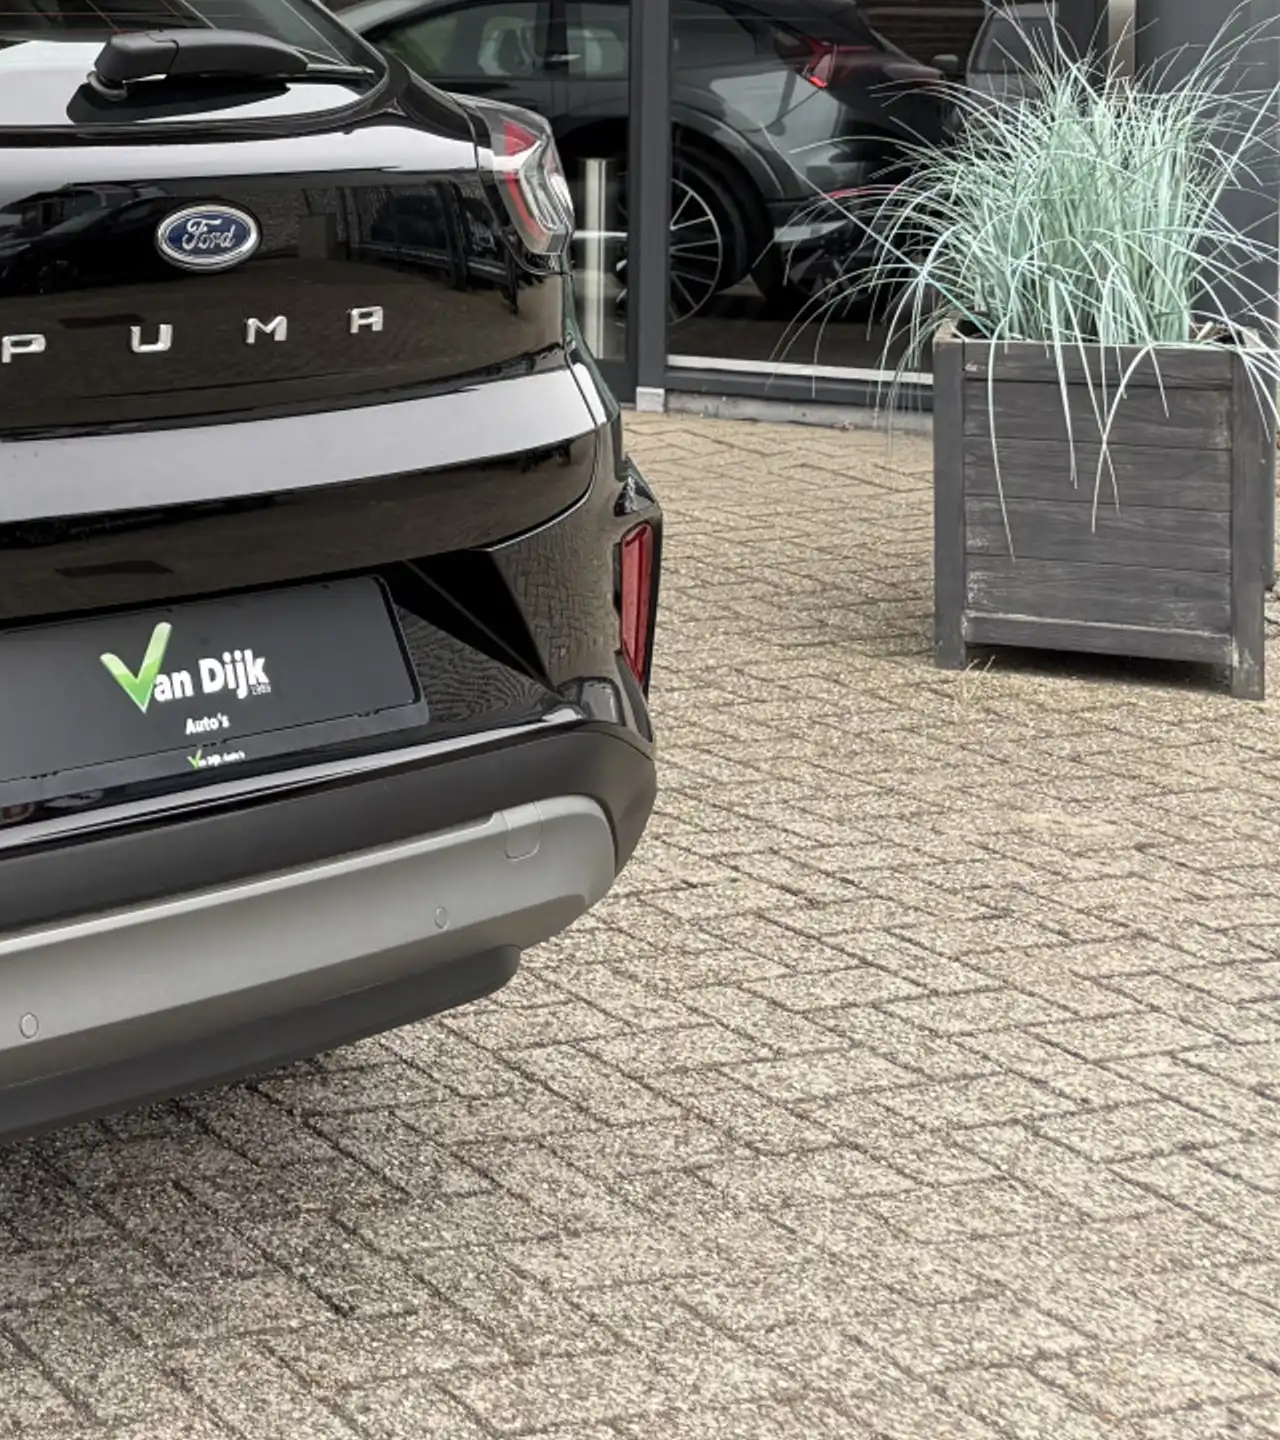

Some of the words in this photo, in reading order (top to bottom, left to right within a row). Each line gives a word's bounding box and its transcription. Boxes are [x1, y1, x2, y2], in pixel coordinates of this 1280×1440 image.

[182, 218, 236, 250] Ford
[0, 304, 386, 364] PUMA
[198, 648, 271, 700] Dijk
[185, 712, 231, 736] Auto's
